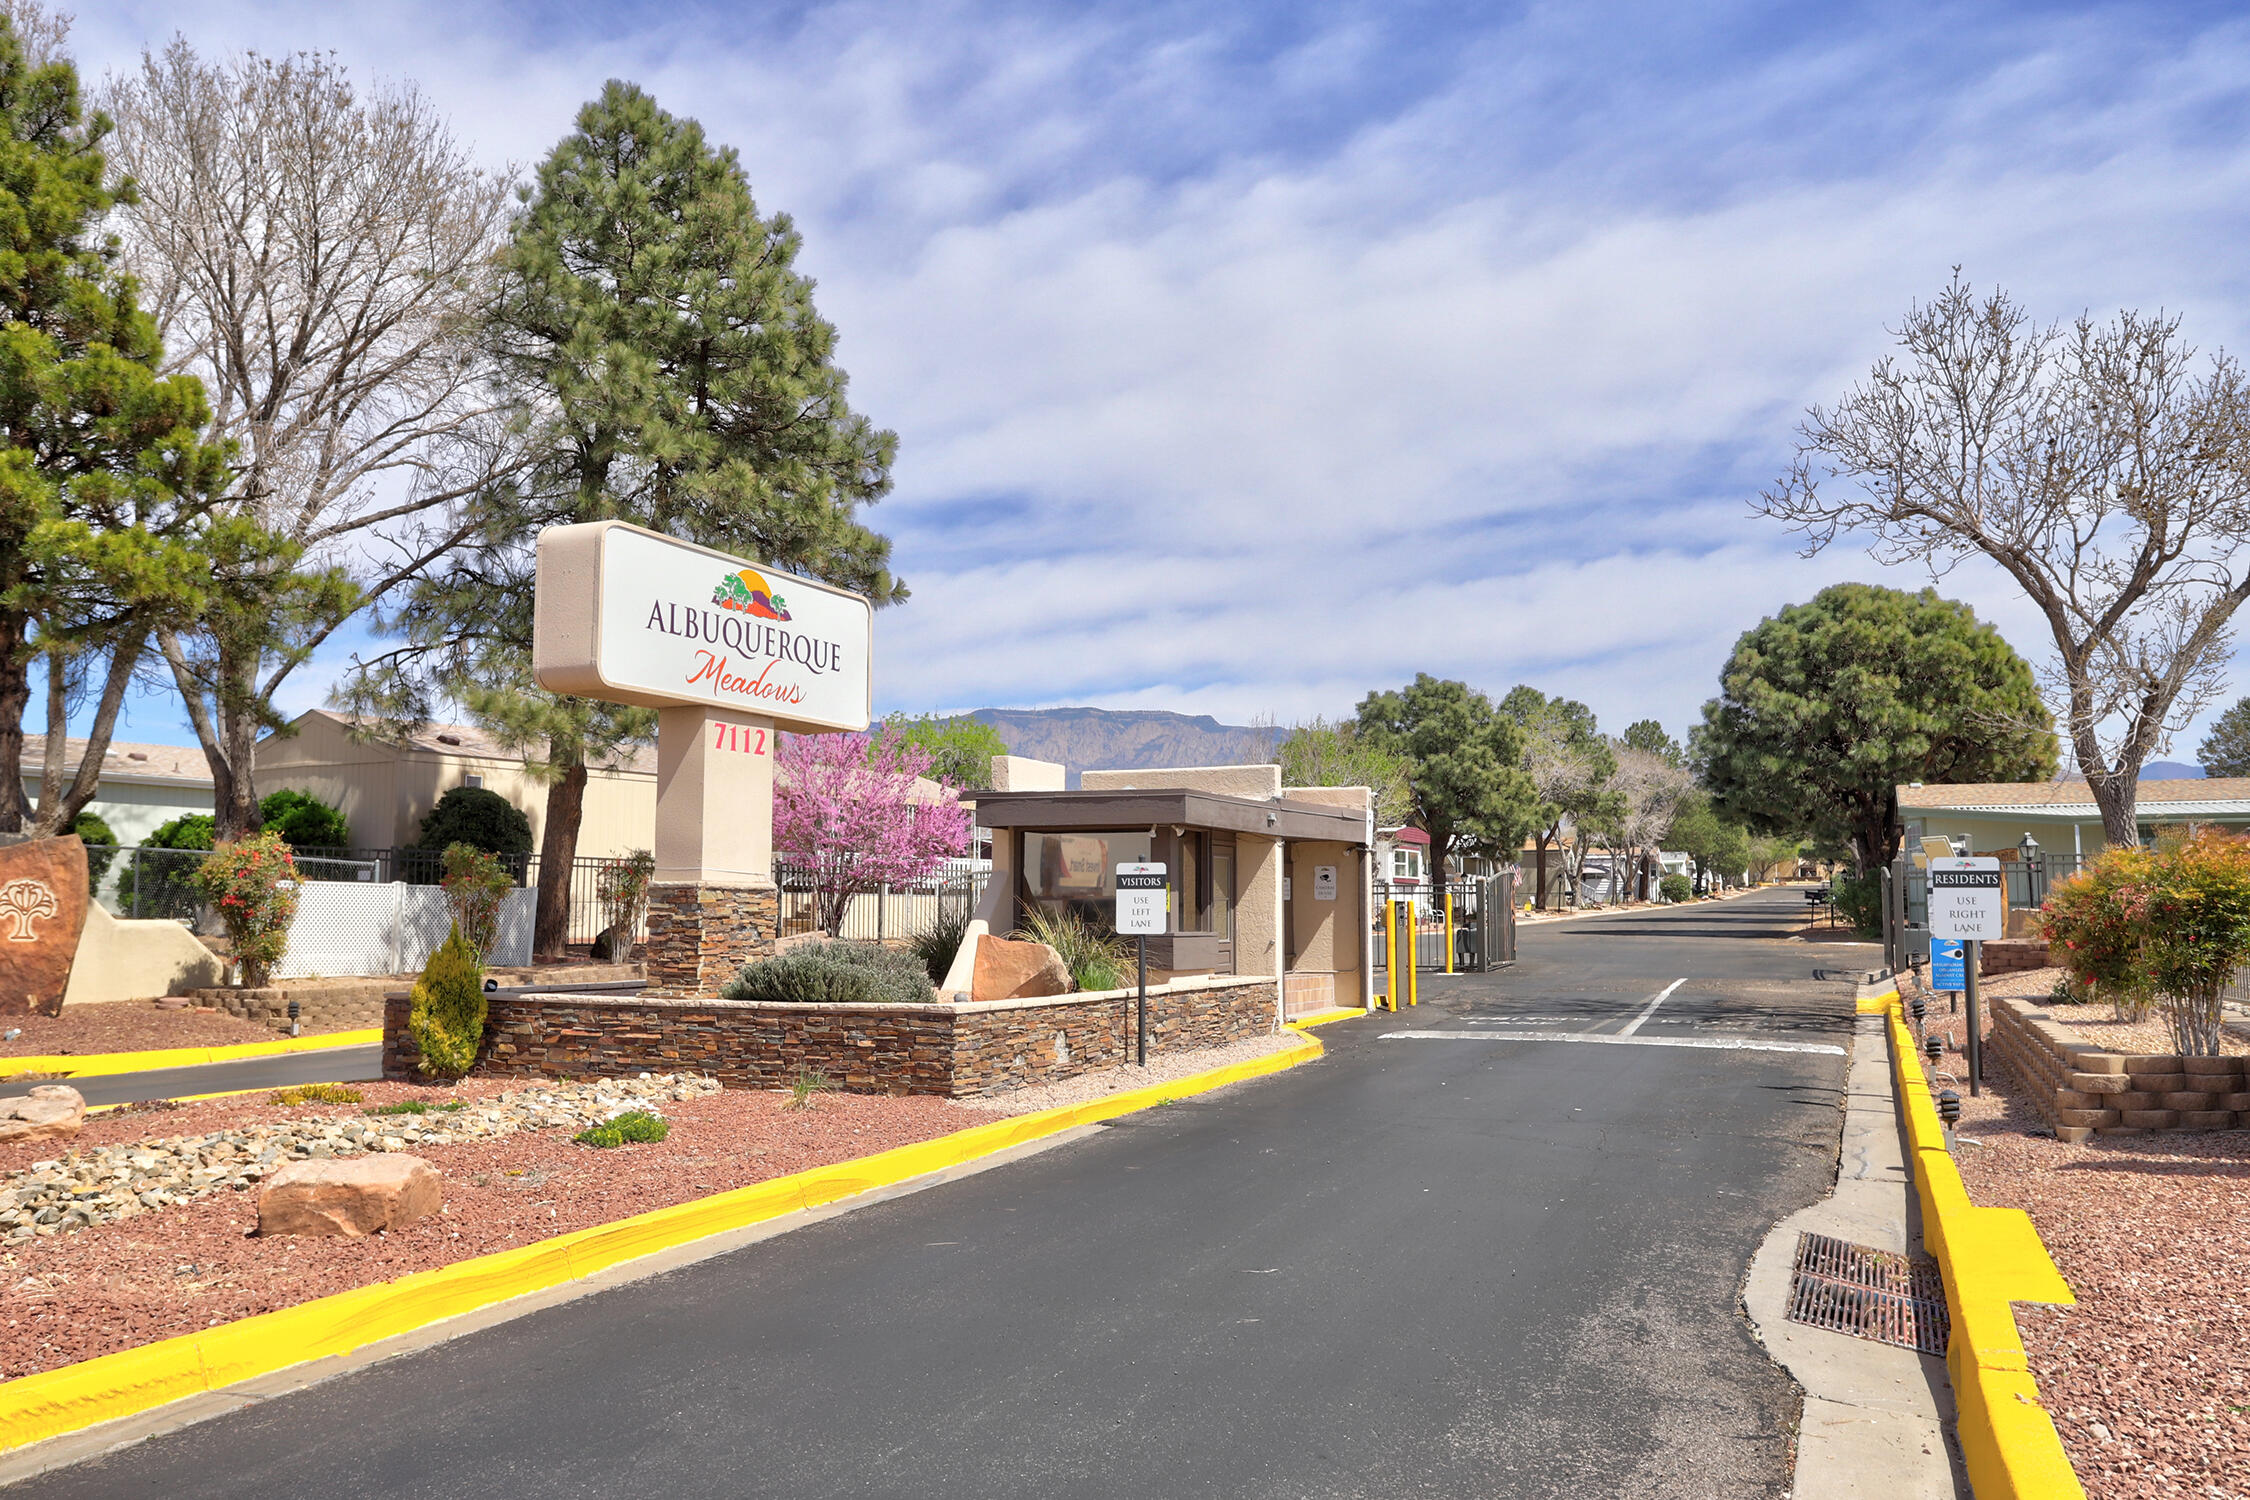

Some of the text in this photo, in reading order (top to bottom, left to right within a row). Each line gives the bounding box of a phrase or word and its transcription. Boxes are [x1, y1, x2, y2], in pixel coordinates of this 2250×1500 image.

[646, 599, 841, 675] ALBUQUERQUE
[685, 649, 807, 704] Meadows
[714, 722, 766, 756] 7112
[1121, 878, 1161, 886] VISITORS
[1935, 874, 1998, 884] RESIDENTS
[1956, 897, 1976, 905] USE
[1132, 908, 1150, 916] LEFT
[1949, 910, 1986, 919] RIGHT
[1954, 923, 1983, 933] LANE
